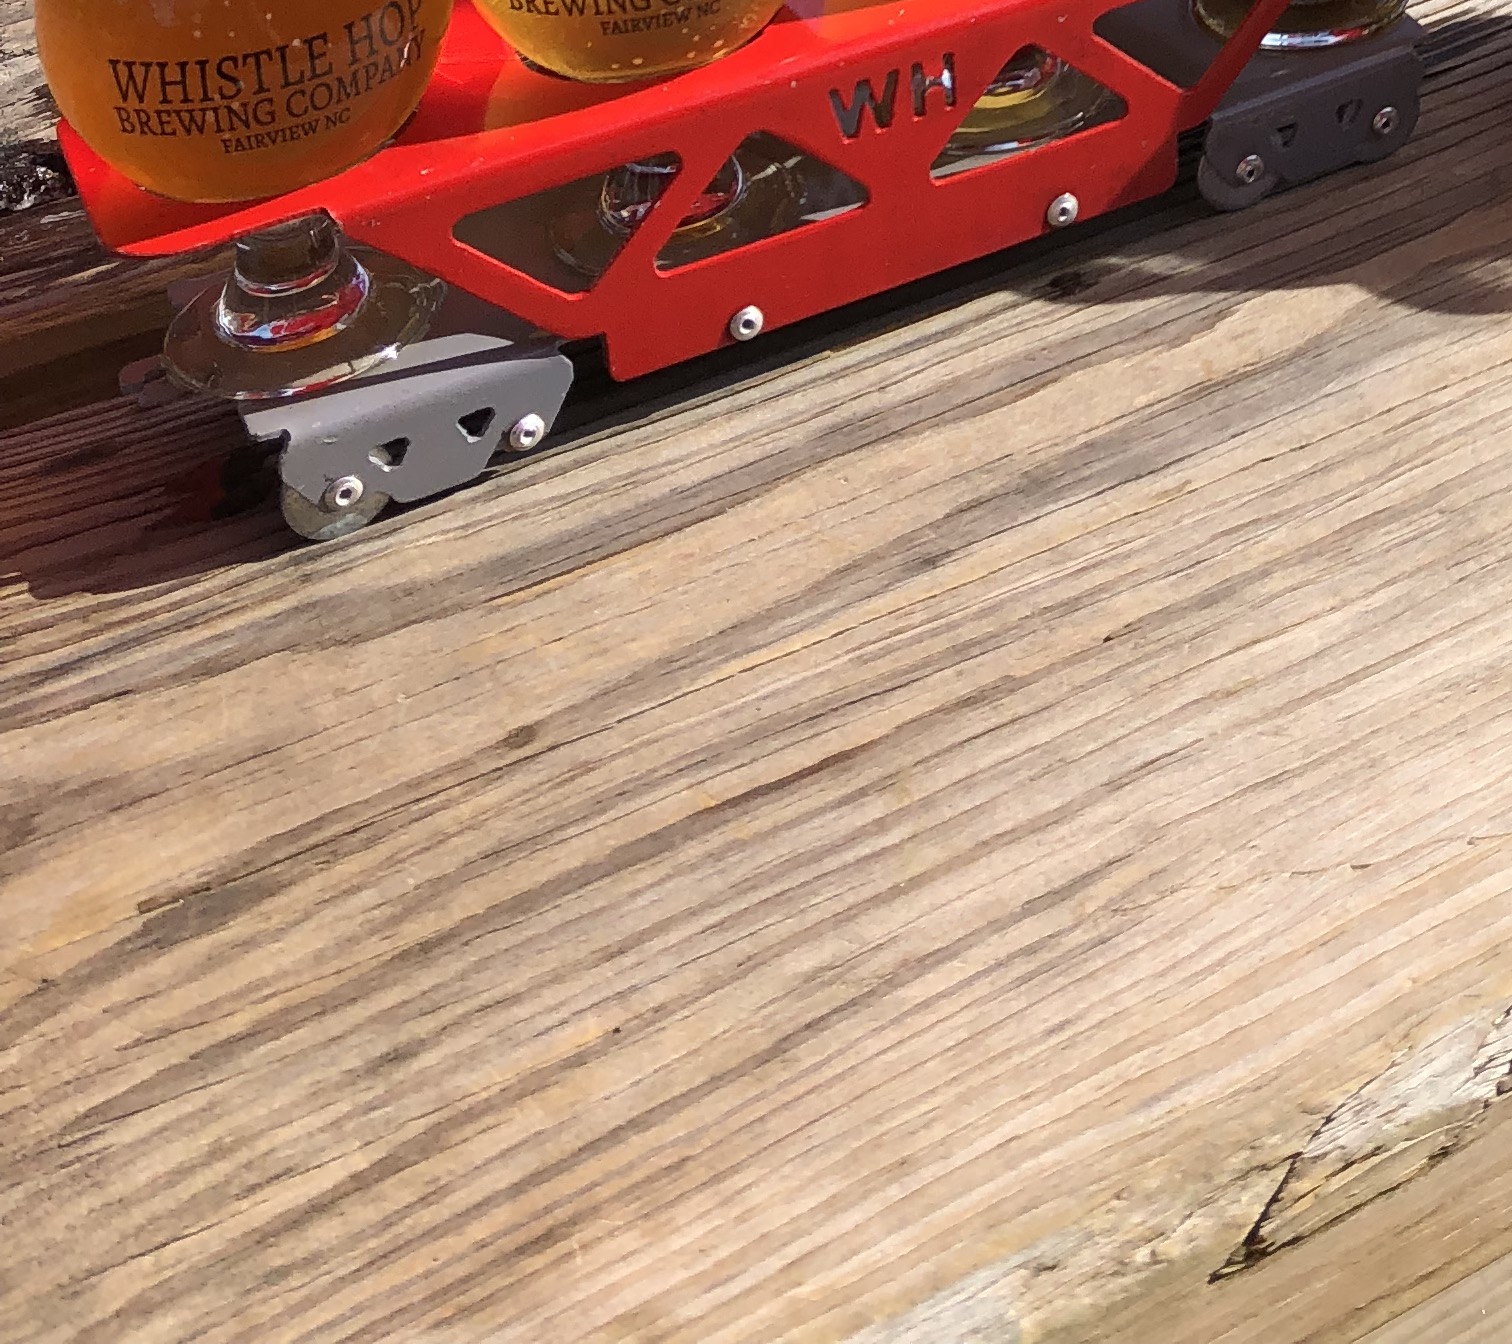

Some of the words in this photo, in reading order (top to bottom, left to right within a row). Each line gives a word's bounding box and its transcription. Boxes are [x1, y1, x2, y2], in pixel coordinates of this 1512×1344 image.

[601, 8, 692, 36] FAIRVIEW
[108, 32, 333, 104] WHISTLE
[113, 97, 276, 136] BREWING
[286, 28, 425, 119] COMPANY
[829, 52, 957, 138] WH
[220, 120, 320, 155] FAIRVIEW
[325, 109, 351, 132] NC
